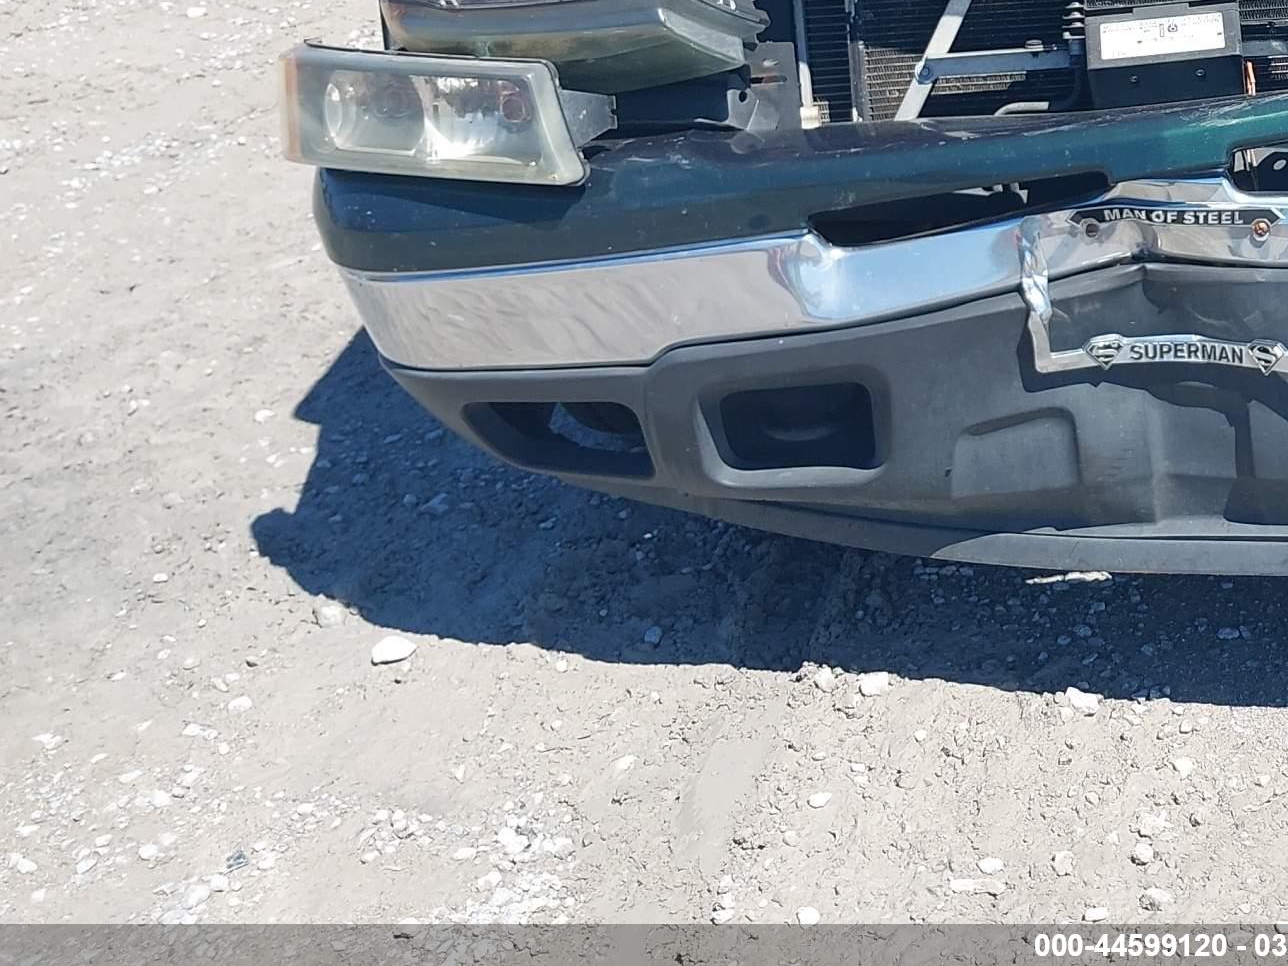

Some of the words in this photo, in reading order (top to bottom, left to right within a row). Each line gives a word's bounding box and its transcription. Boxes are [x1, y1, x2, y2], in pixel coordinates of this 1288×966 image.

[1103, 208, 1146, 221] MAN
[1151, 210, 1178, 223] OF
[1183, 211, 1244, 224] STEEL
[1130, 343, 1244, 364] SUPERMAN
